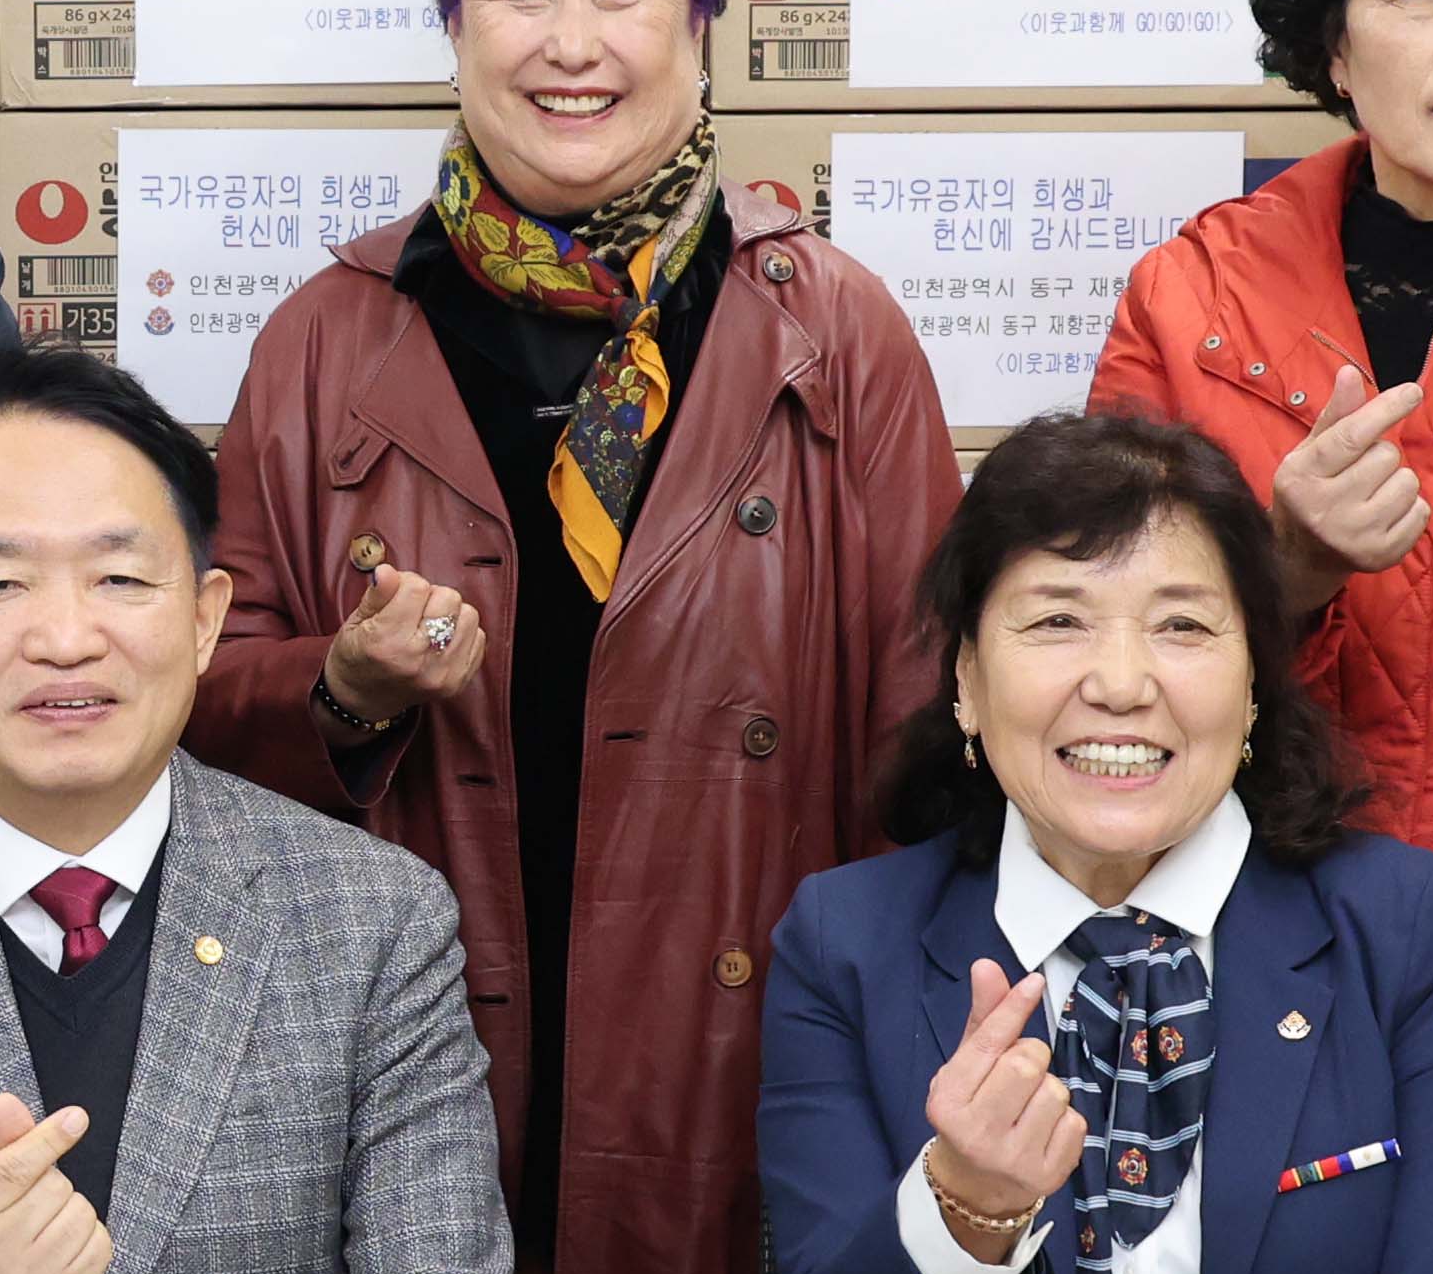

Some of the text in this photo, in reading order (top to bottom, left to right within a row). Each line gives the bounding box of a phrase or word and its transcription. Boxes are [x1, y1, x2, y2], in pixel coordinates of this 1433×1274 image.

[65, 9, 84, 21] 86
[780, 10, 799, 23] 86
[140, 175, 401, 209] 국가유공자의 희생과
[853, 178, 1113, 212] 국가유공자의 희생과
[222, 215, 299, 247] 헌신에
[934, 218, 1011, 251] 헌신에
[902, 278, 1013, 298] 인천광역시
[1030, 278, 1073, 298] 동구
[1003, 315, 1036, 336] 동구
